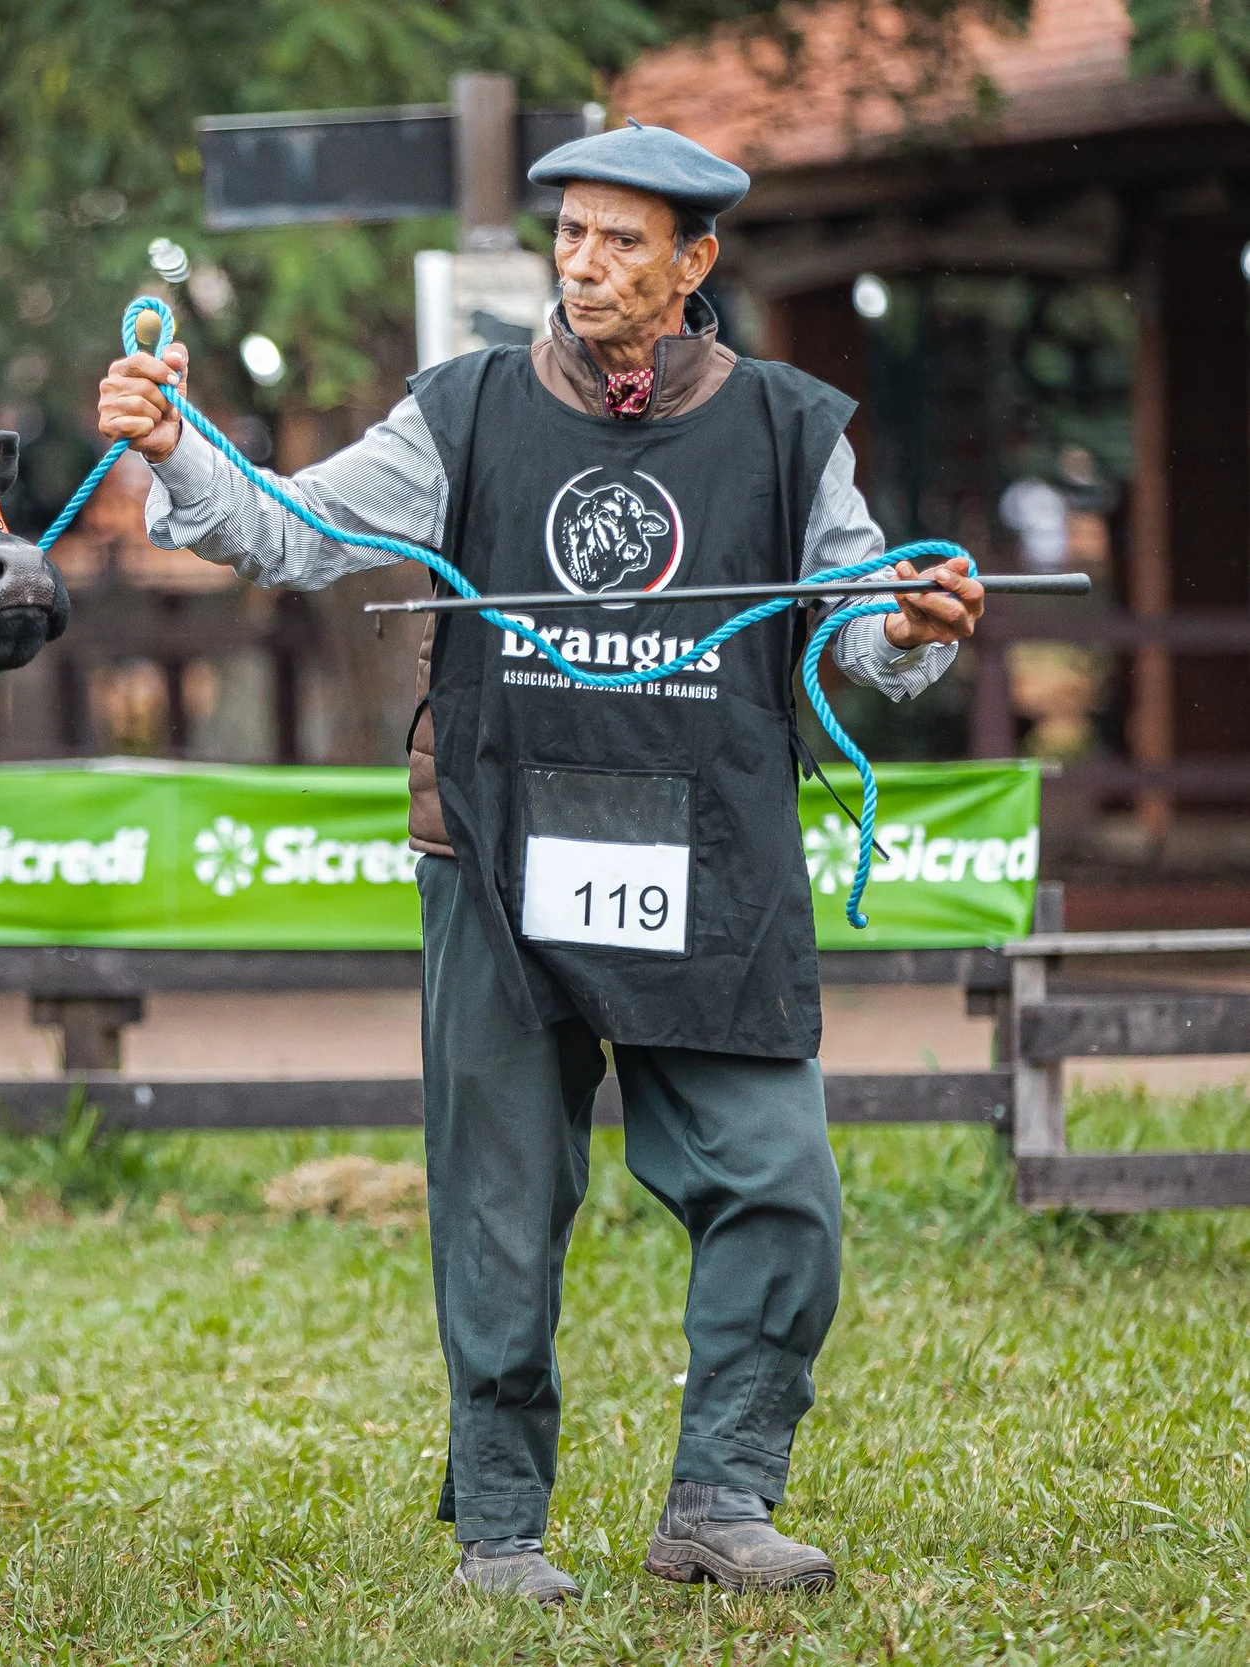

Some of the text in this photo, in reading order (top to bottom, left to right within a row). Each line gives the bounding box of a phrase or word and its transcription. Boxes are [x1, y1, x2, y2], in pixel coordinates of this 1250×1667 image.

[502, 612, 721, 673] Brangus
[503, 670, 571, 689] ASSOCIAÇÃO
[646, 682, 661, 696] DE
[665, 684, 718, 700] BRANGUS
[575, 881, 669, 931] 119
